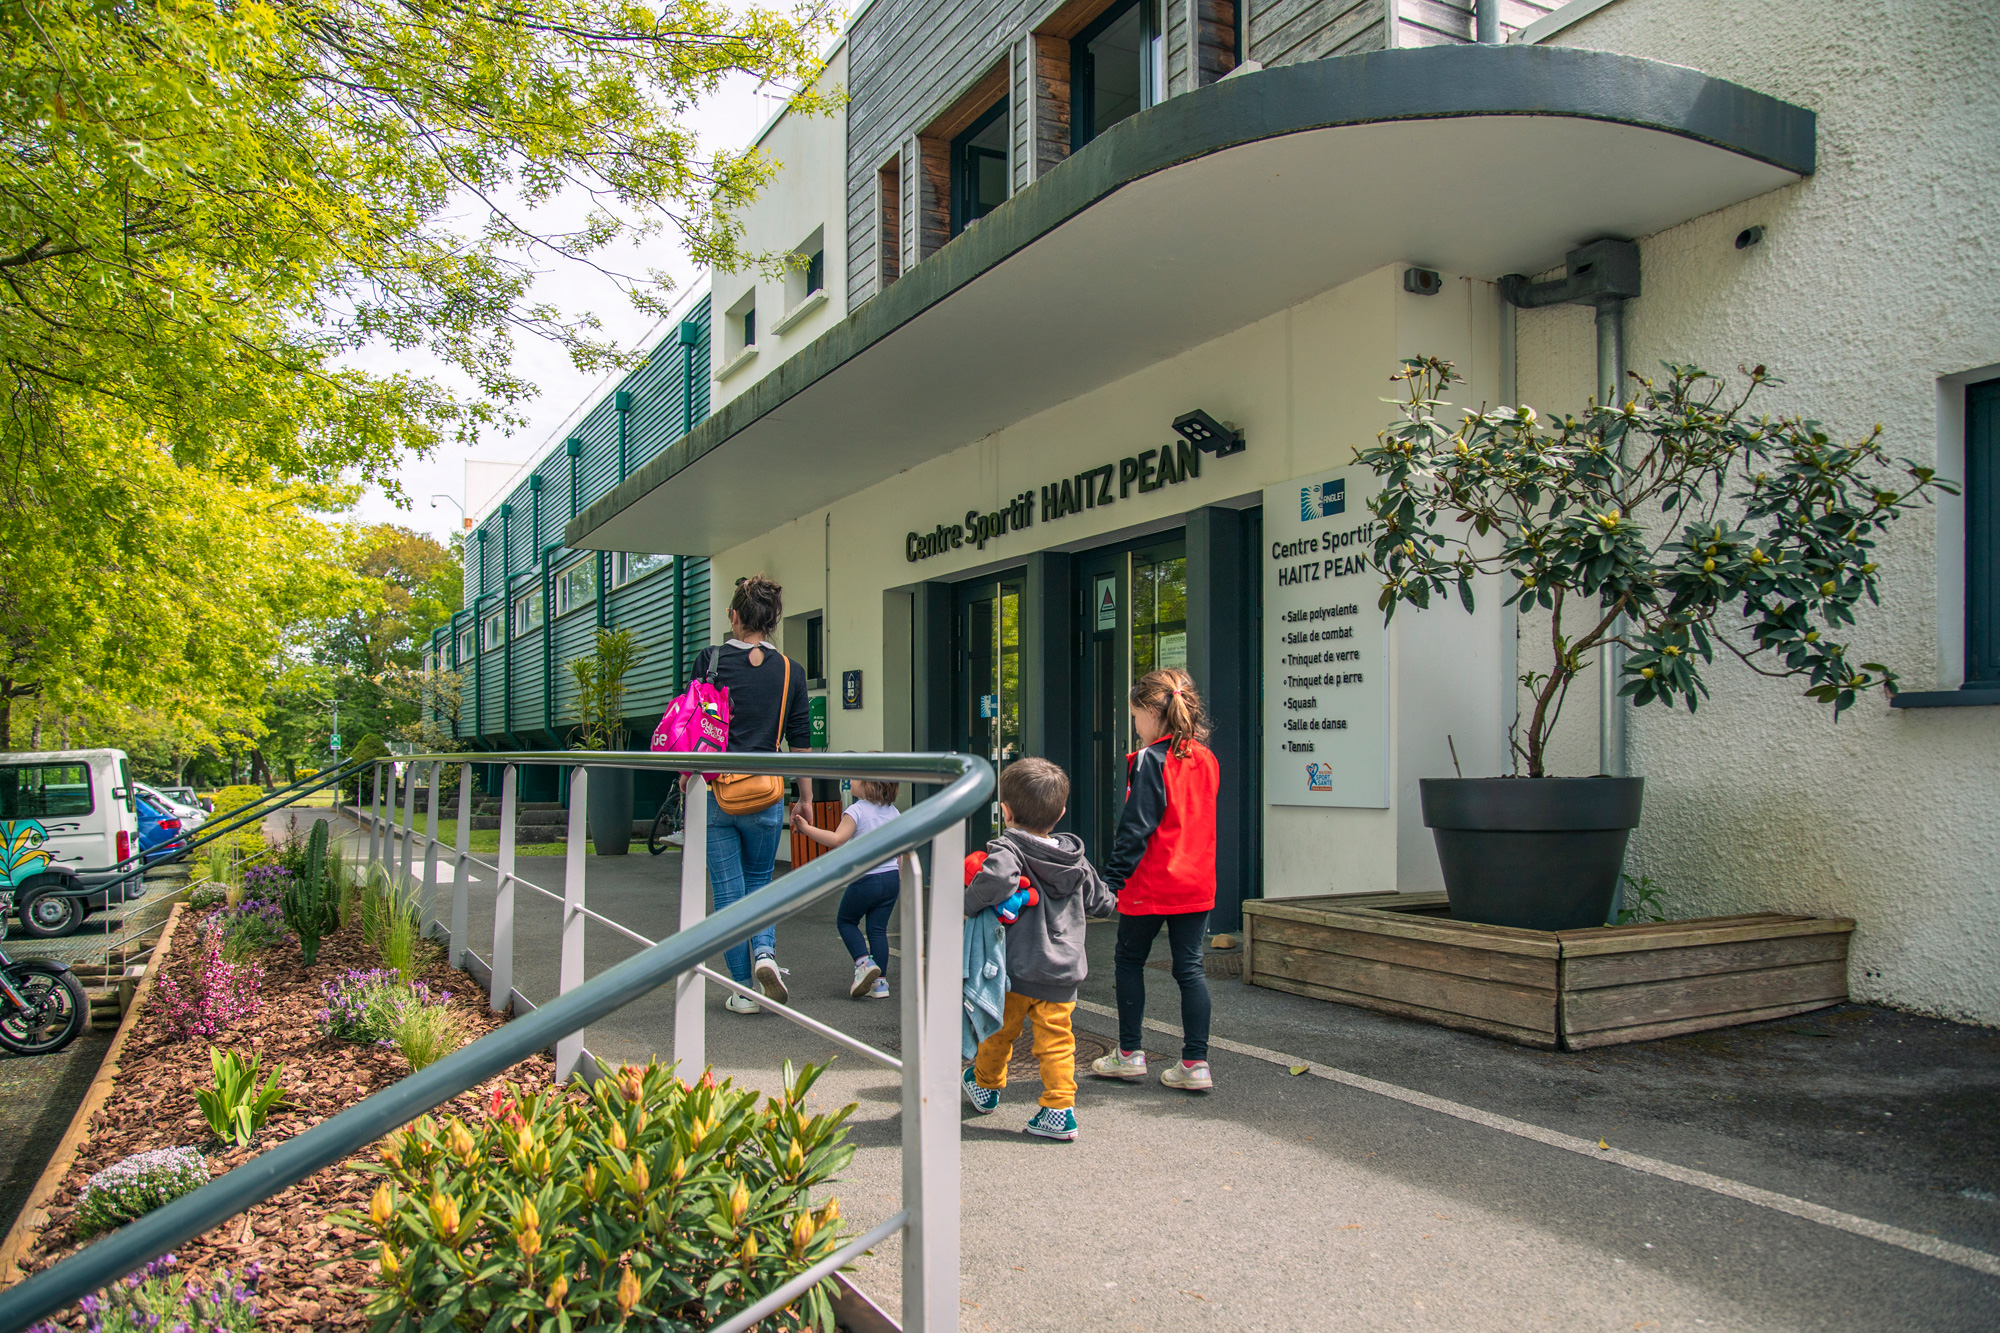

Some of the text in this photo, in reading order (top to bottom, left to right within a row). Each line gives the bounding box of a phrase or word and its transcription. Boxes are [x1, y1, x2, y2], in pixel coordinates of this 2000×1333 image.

[906, 439, 1202, 563] Centre Sportif HAITZ PEAN
[1323, 491, 1345, 504] ANGLET
[1272, 522, 1374, 560] Centre Sportif
[1279, 555, 1366, 586] HAITZ PEAN
[1287, 603, 1359, 622] Salle polyvalente
[1287, 626, 1353, 644] Salle de combat
[1287, 650, 1360, 667] Trinquet de verre
[1287, 674, 1321, 689] Trinquet
[1324, 673, 1334, 685] de
[1287, 696, 1317, 711] Squash
[1287, 717, 1347, 731] Salle de danse
[1287, 740, 1314, 753] Tennis
